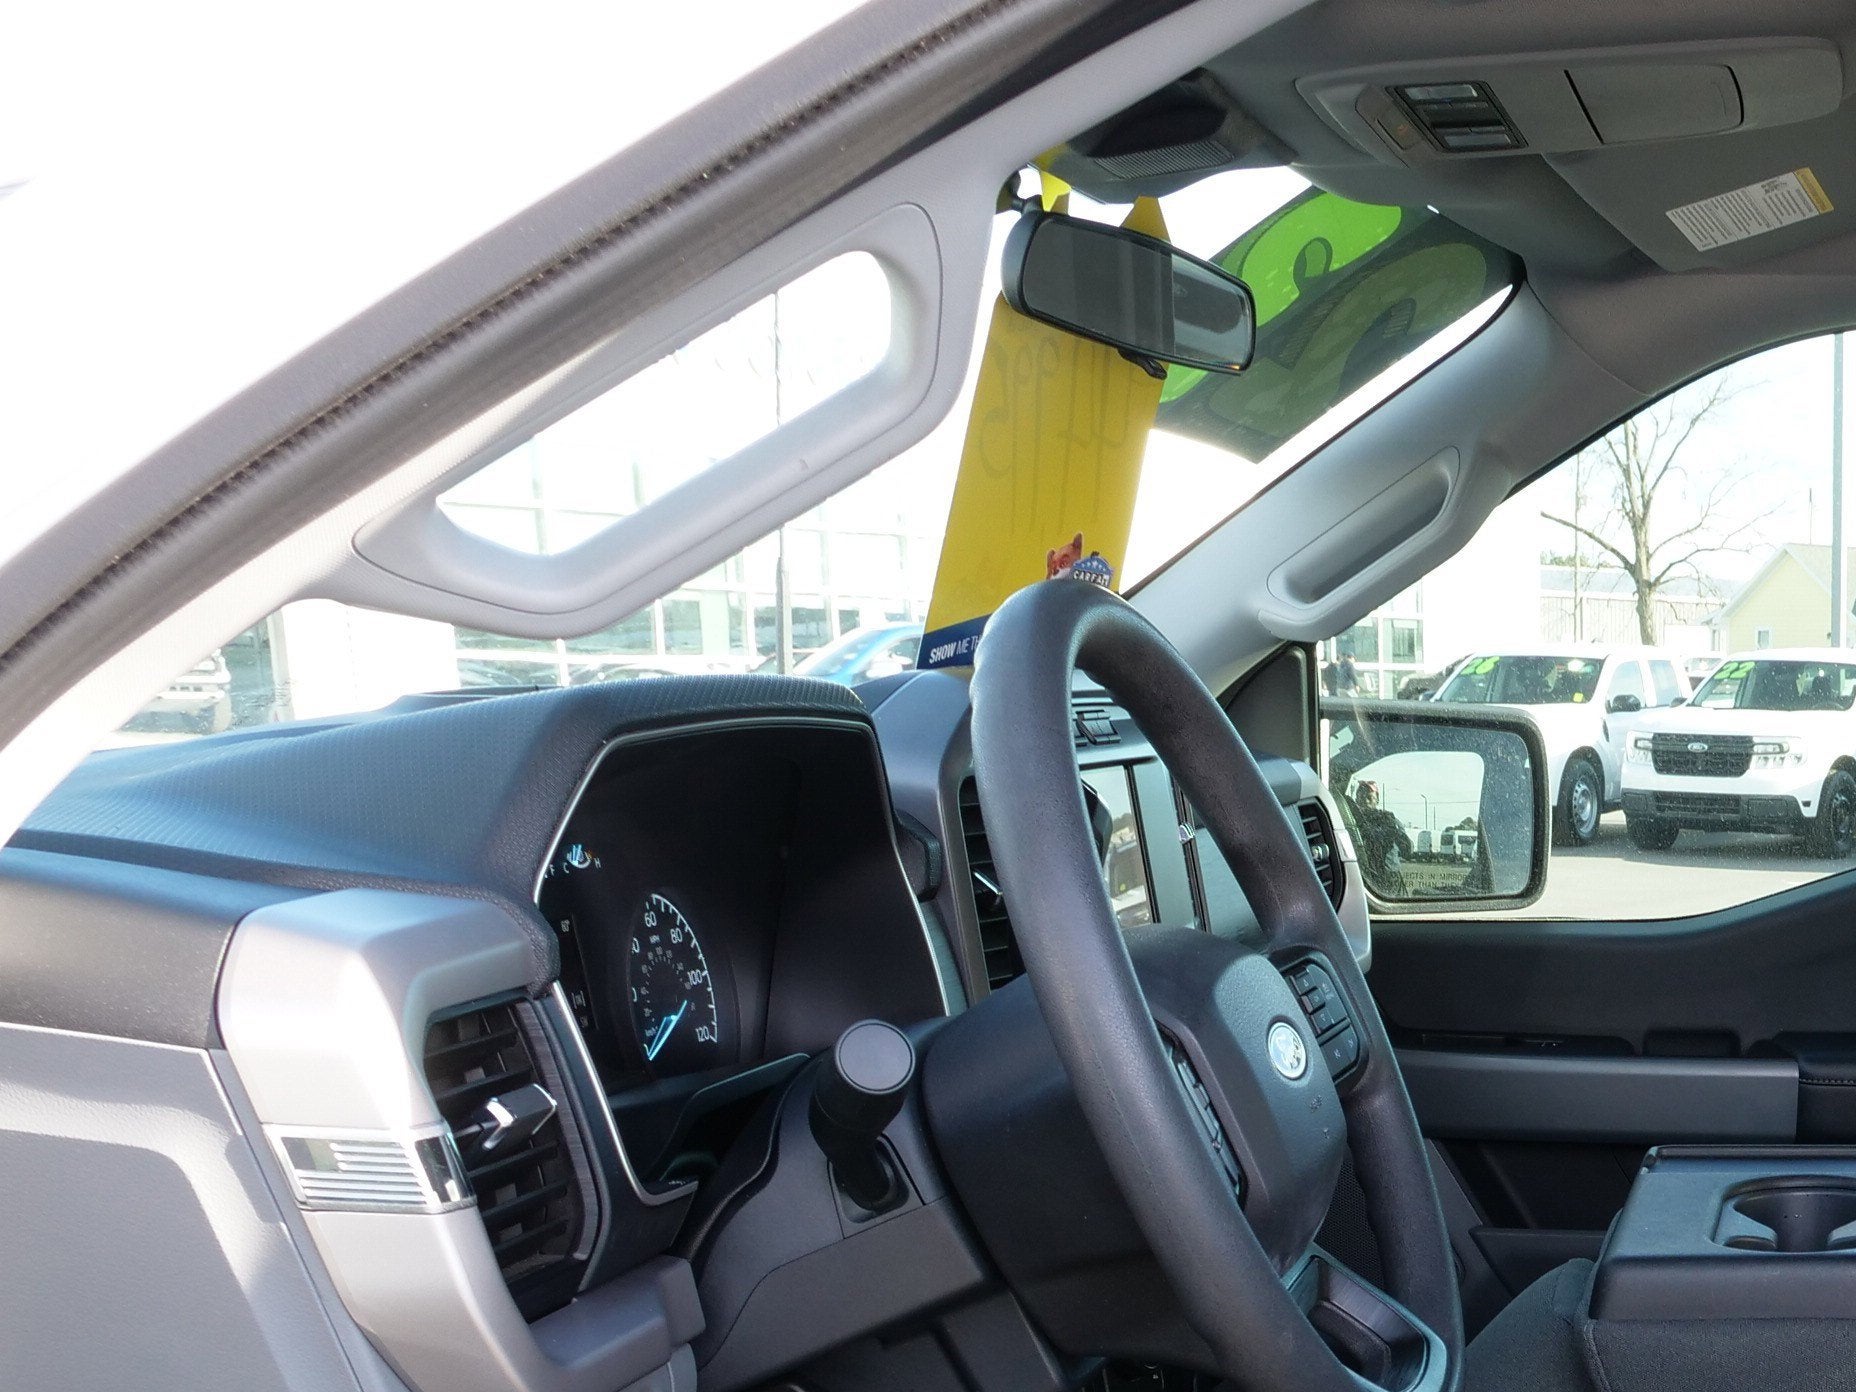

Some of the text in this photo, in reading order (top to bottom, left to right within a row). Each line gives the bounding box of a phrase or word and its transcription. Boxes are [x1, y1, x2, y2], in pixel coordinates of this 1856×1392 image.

[928, 633, 982, 664] SHOW ME TH
[1714, 660, 1756, 680] 22
[645, 911, 657, 928] 60
[669, 927, 683, 944] 80
[687, 969, 703, 986] 100
[695, 1025, 710, 1043] 120
